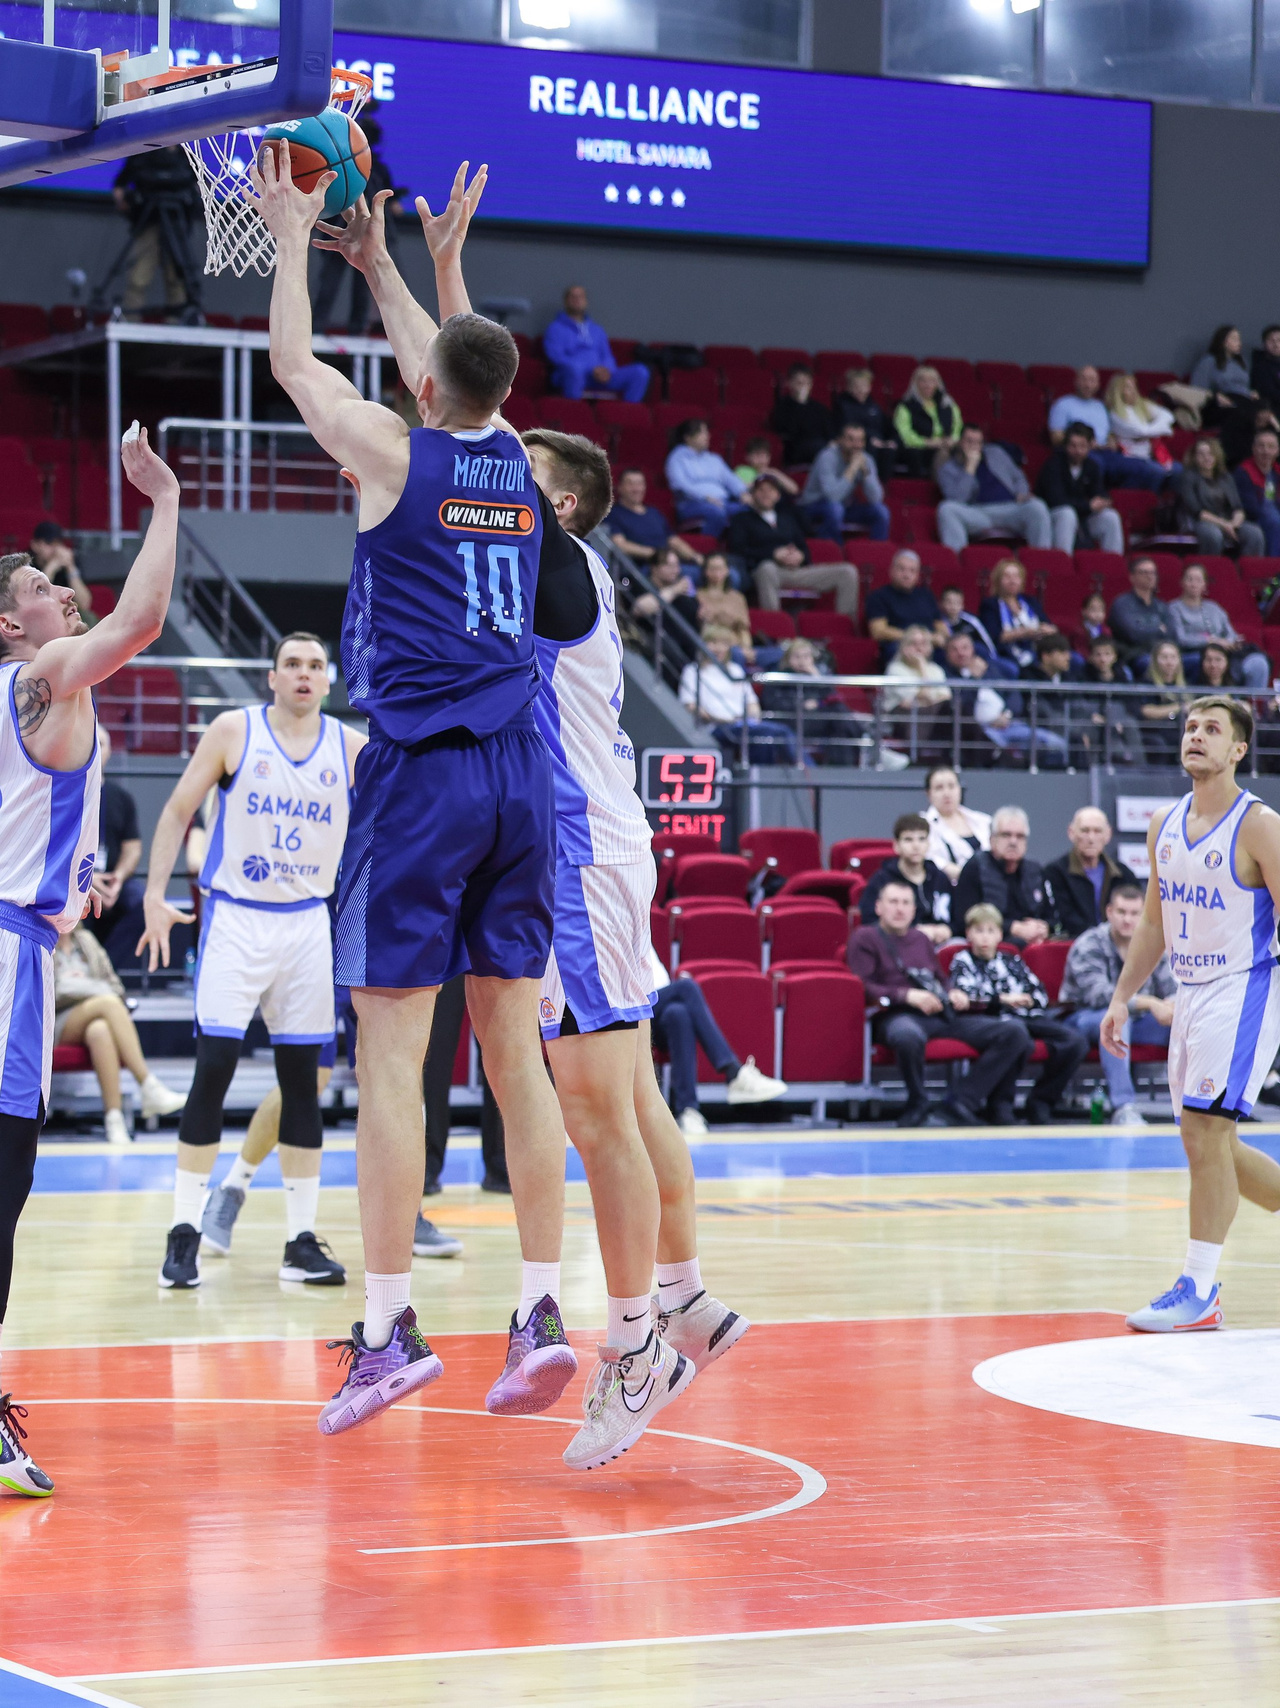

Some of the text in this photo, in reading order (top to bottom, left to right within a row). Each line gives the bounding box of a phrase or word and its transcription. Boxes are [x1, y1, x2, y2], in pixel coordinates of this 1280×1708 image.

[529, 75, 761, 130] REALLIANCE
[454, 454, 525, 492] MARTIUK
[447, 505, 516, 528] WINLINE
[456, 541, 523, 637] 10
[246, 792, 332, 826] SAMARA
[271, 824, 302, 852] 16
[1178, 911, 1189, 939] 1
[1174, 952, 1227, 967] РОССЕТИ
